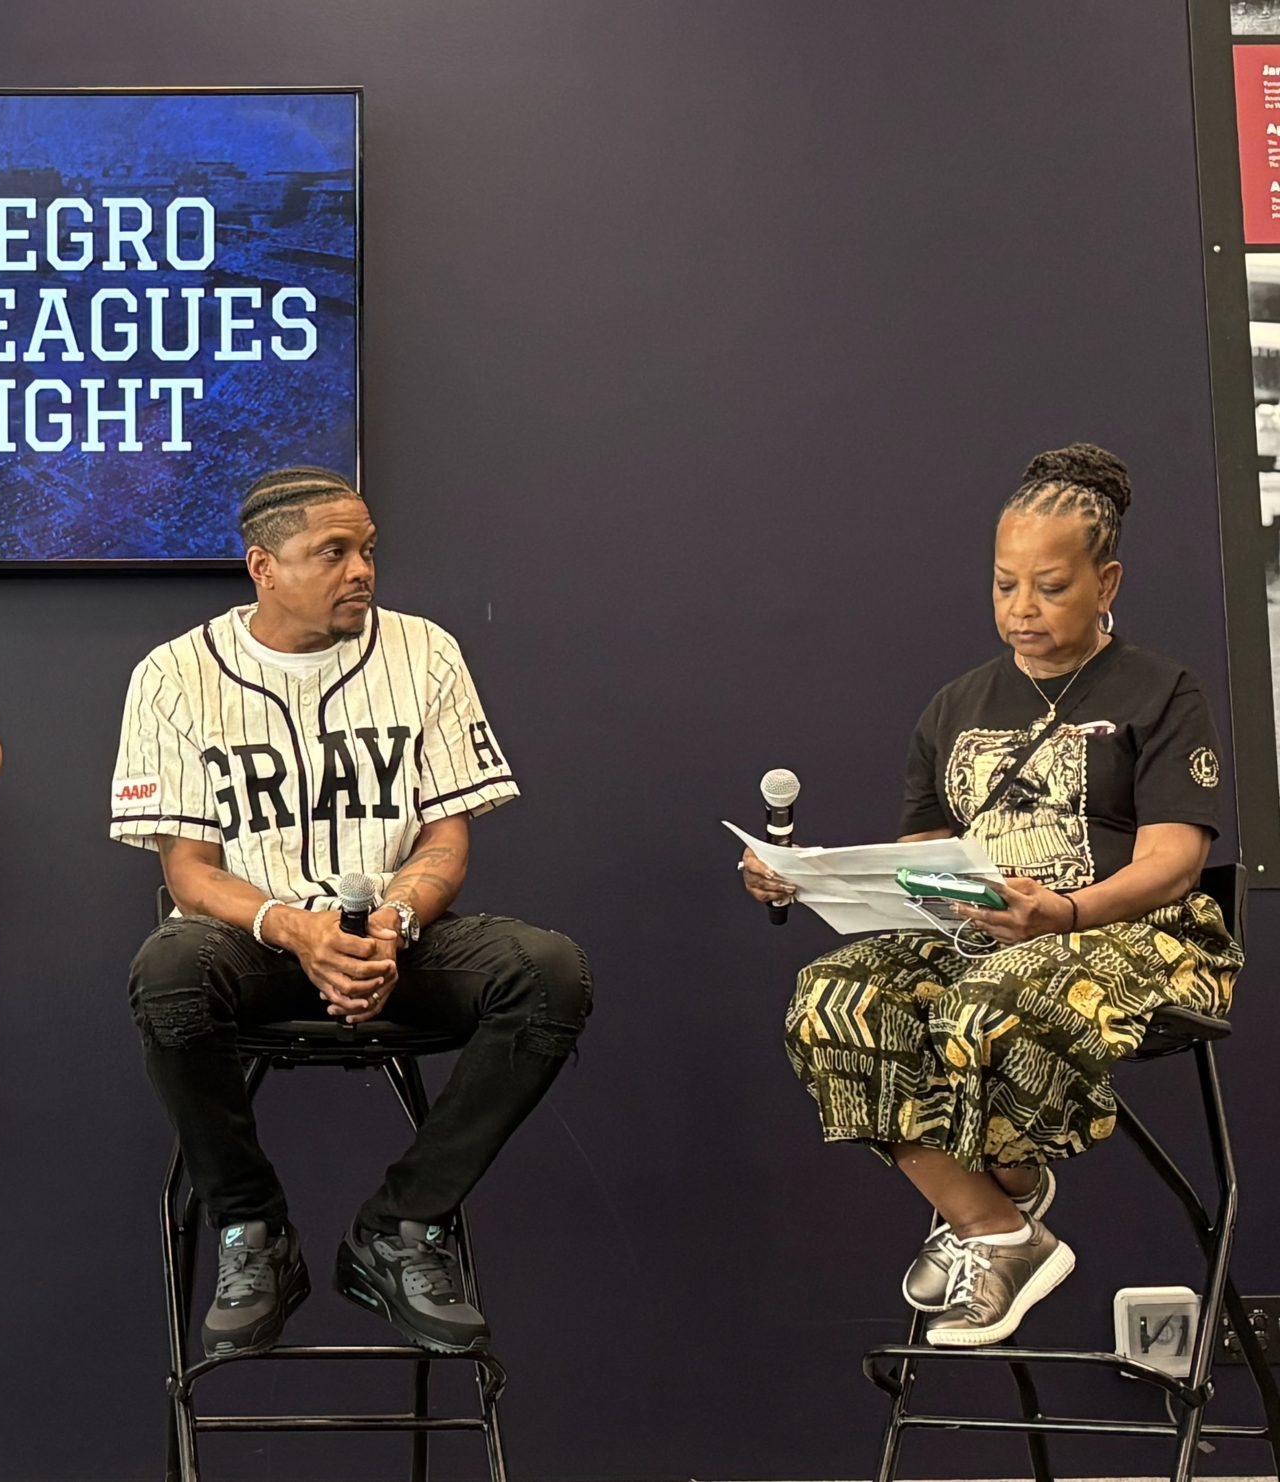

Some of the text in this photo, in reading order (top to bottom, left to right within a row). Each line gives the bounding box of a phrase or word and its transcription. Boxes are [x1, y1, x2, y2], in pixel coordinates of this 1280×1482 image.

[470, 720, 502, 770] H
[115, 783, 157, 800] AARP
[200, 726, 424, 842] GRAY
